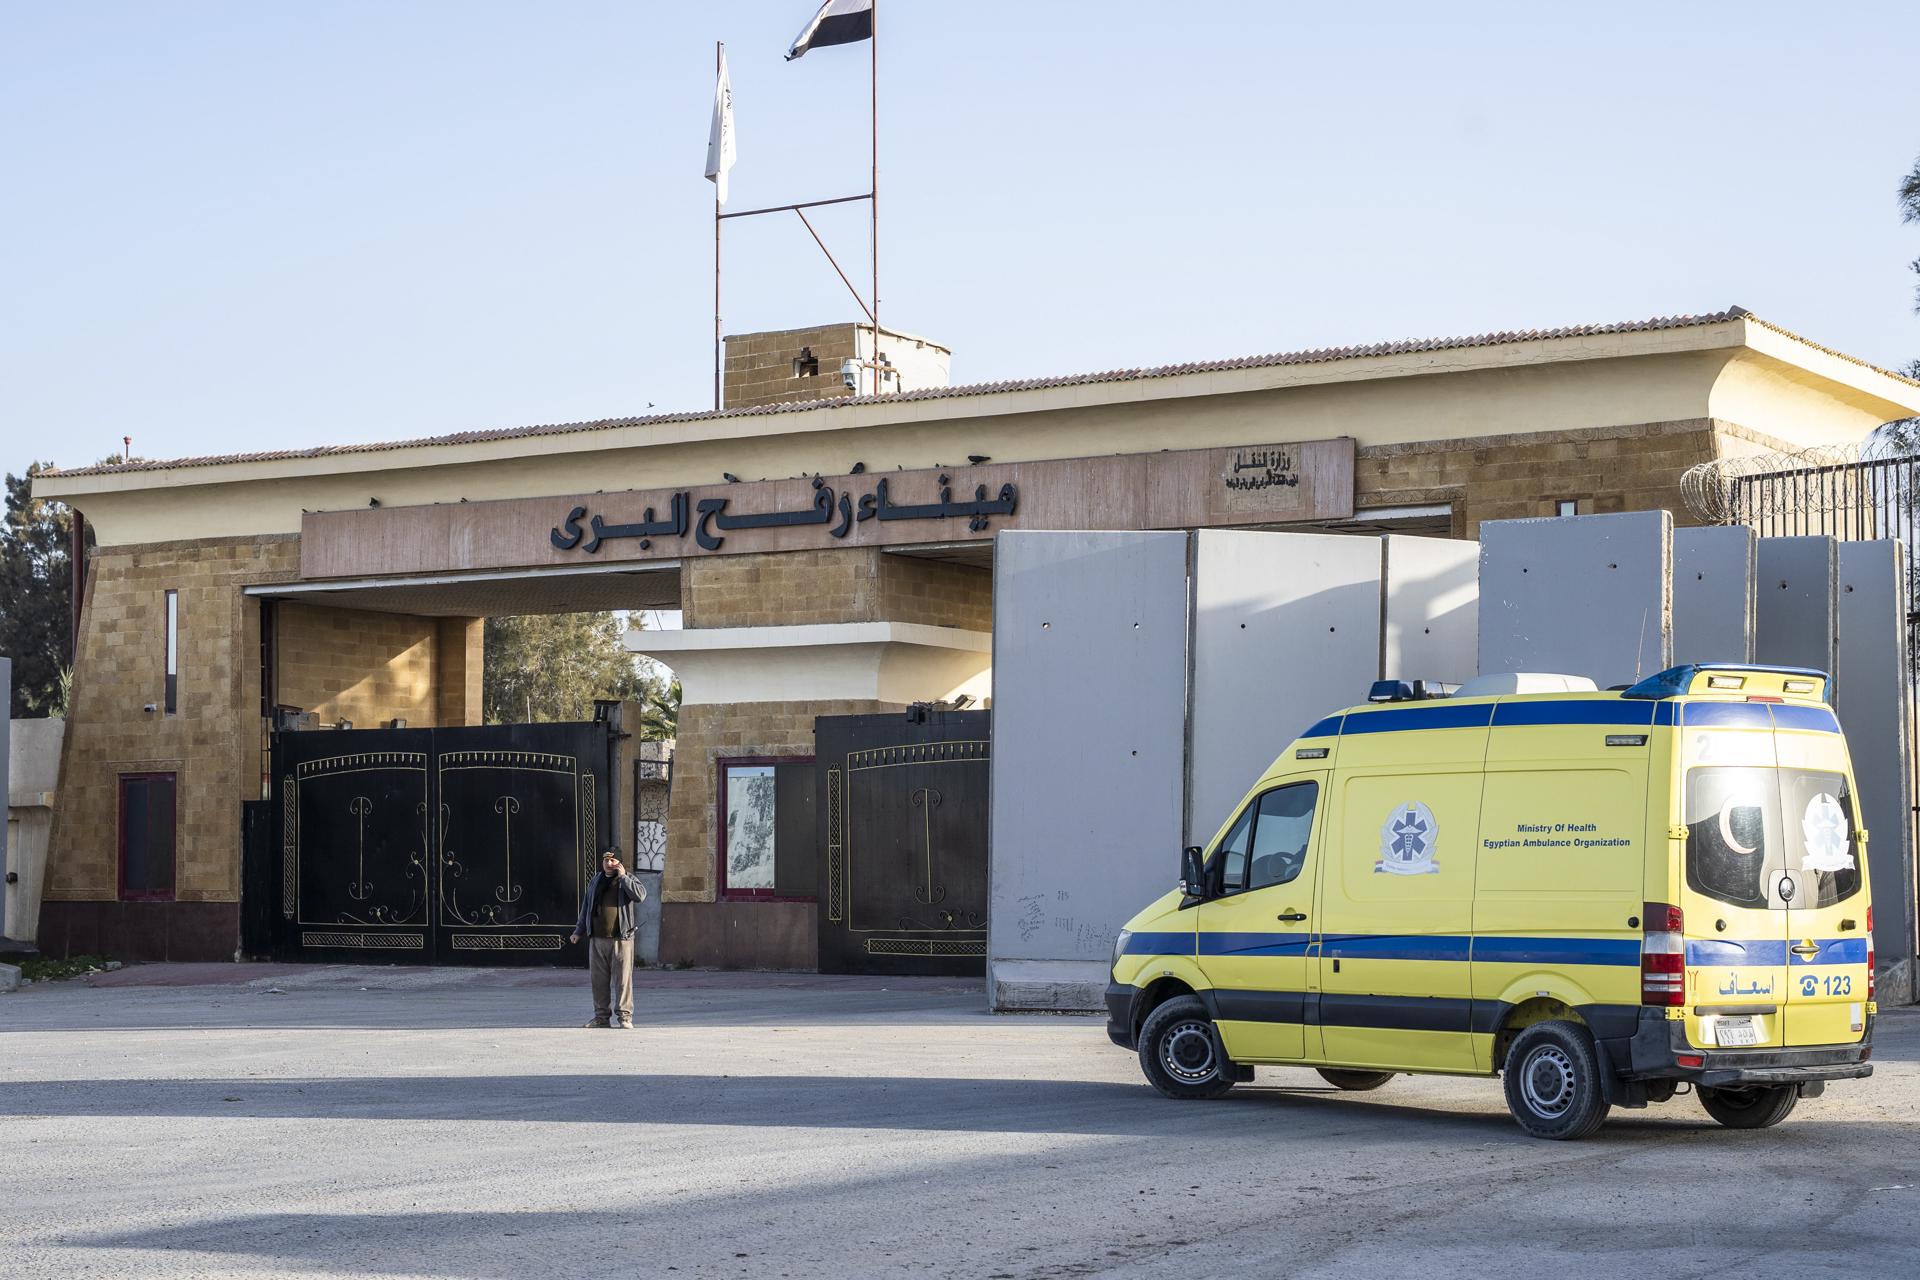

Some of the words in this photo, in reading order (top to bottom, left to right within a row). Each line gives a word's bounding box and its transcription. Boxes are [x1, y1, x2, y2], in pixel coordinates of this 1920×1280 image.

[695, 477, 853, 550] رفح
[856, 473, 1020, 533] ميناء
[1517, 823, 1552, 834] Ministry
[1555, 823, 1565, 832] Of
[1567, 823, 1597, 832] Health
[1483, 839, 1521, 849] Egyptian
[1523, 838, 1571, 847] Ambulance
[1573, 838, 1631, 849] Organization
[1823, 975, 1851, 996] 123
